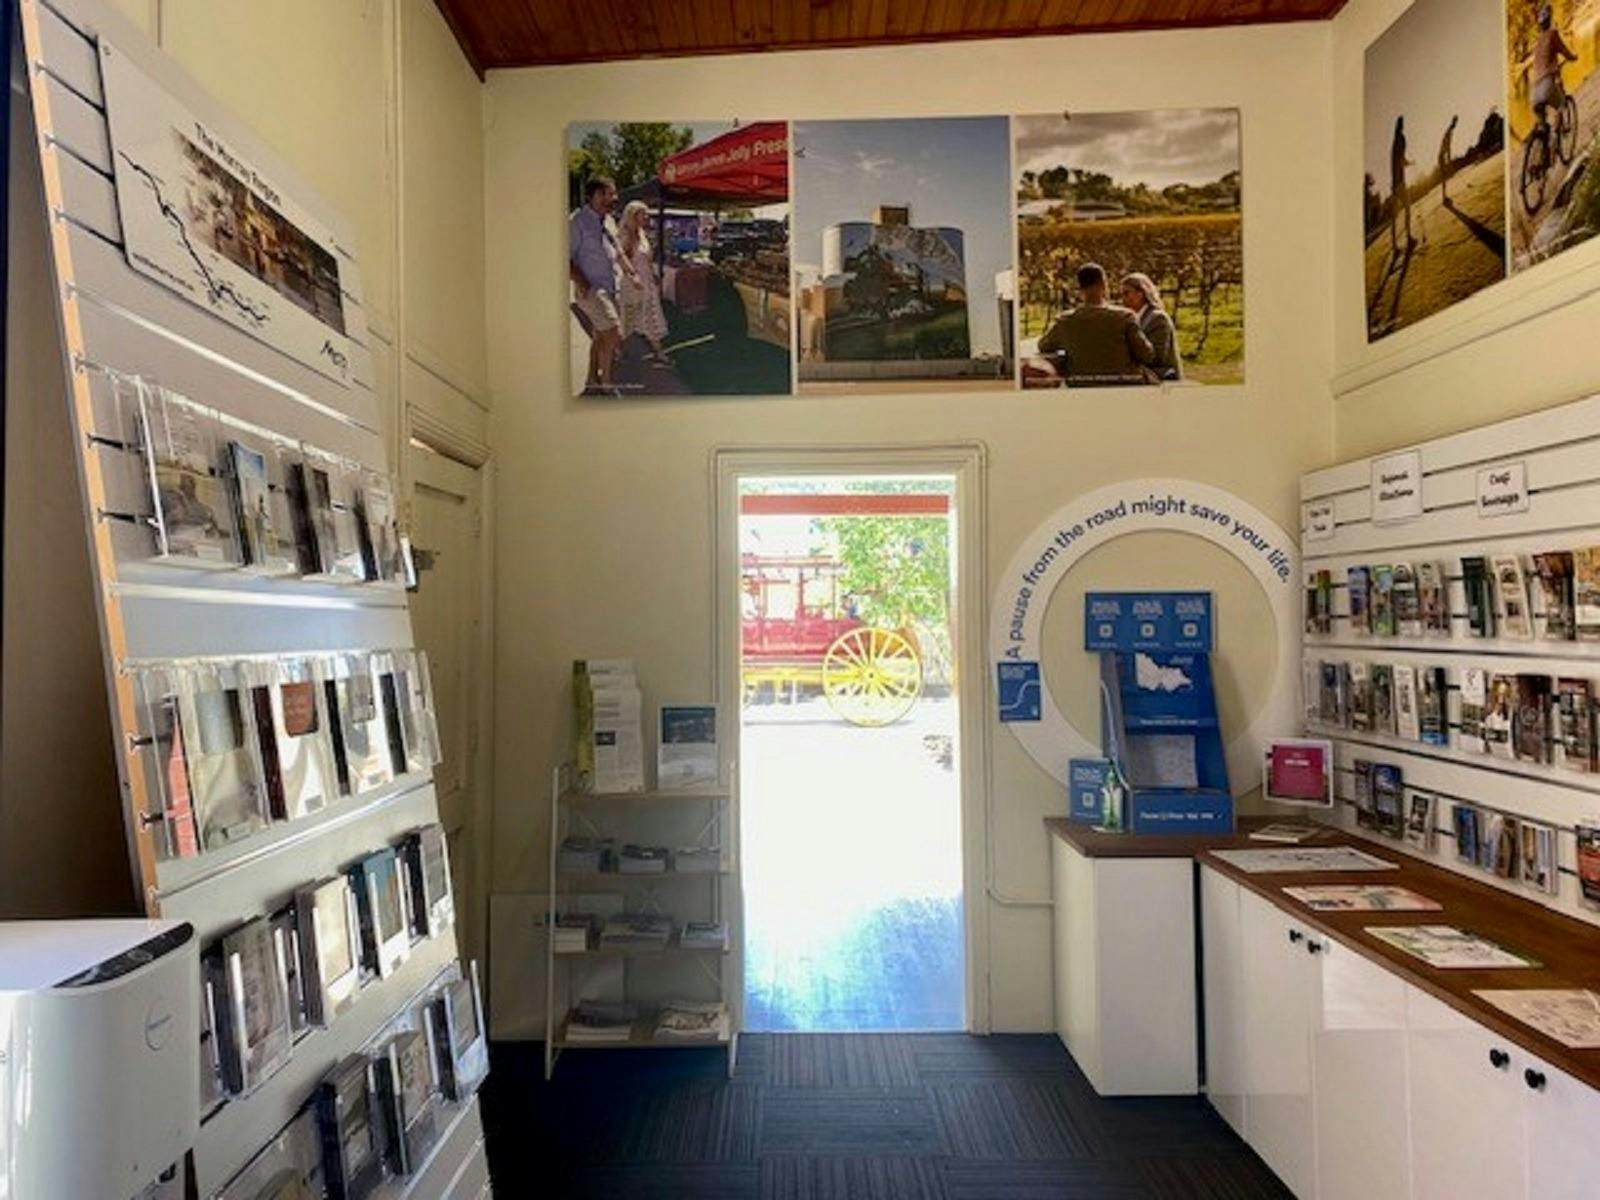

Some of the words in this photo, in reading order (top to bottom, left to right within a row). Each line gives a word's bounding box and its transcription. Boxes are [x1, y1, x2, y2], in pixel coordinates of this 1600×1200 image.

[1085, 500, 1126, 528] road
[1132, 495, 1186, 516] might
[1190, 504, 1231, 526] save
[1054, 523, 1084, 548] the
[1231, 520, 1270, 552] your
[1022, 547, 1058, 585] from
[1267, 548, 1290, 583] life.
[1009, 587, 1032, 641] pause
[1005, 646, 1020, 660] A
